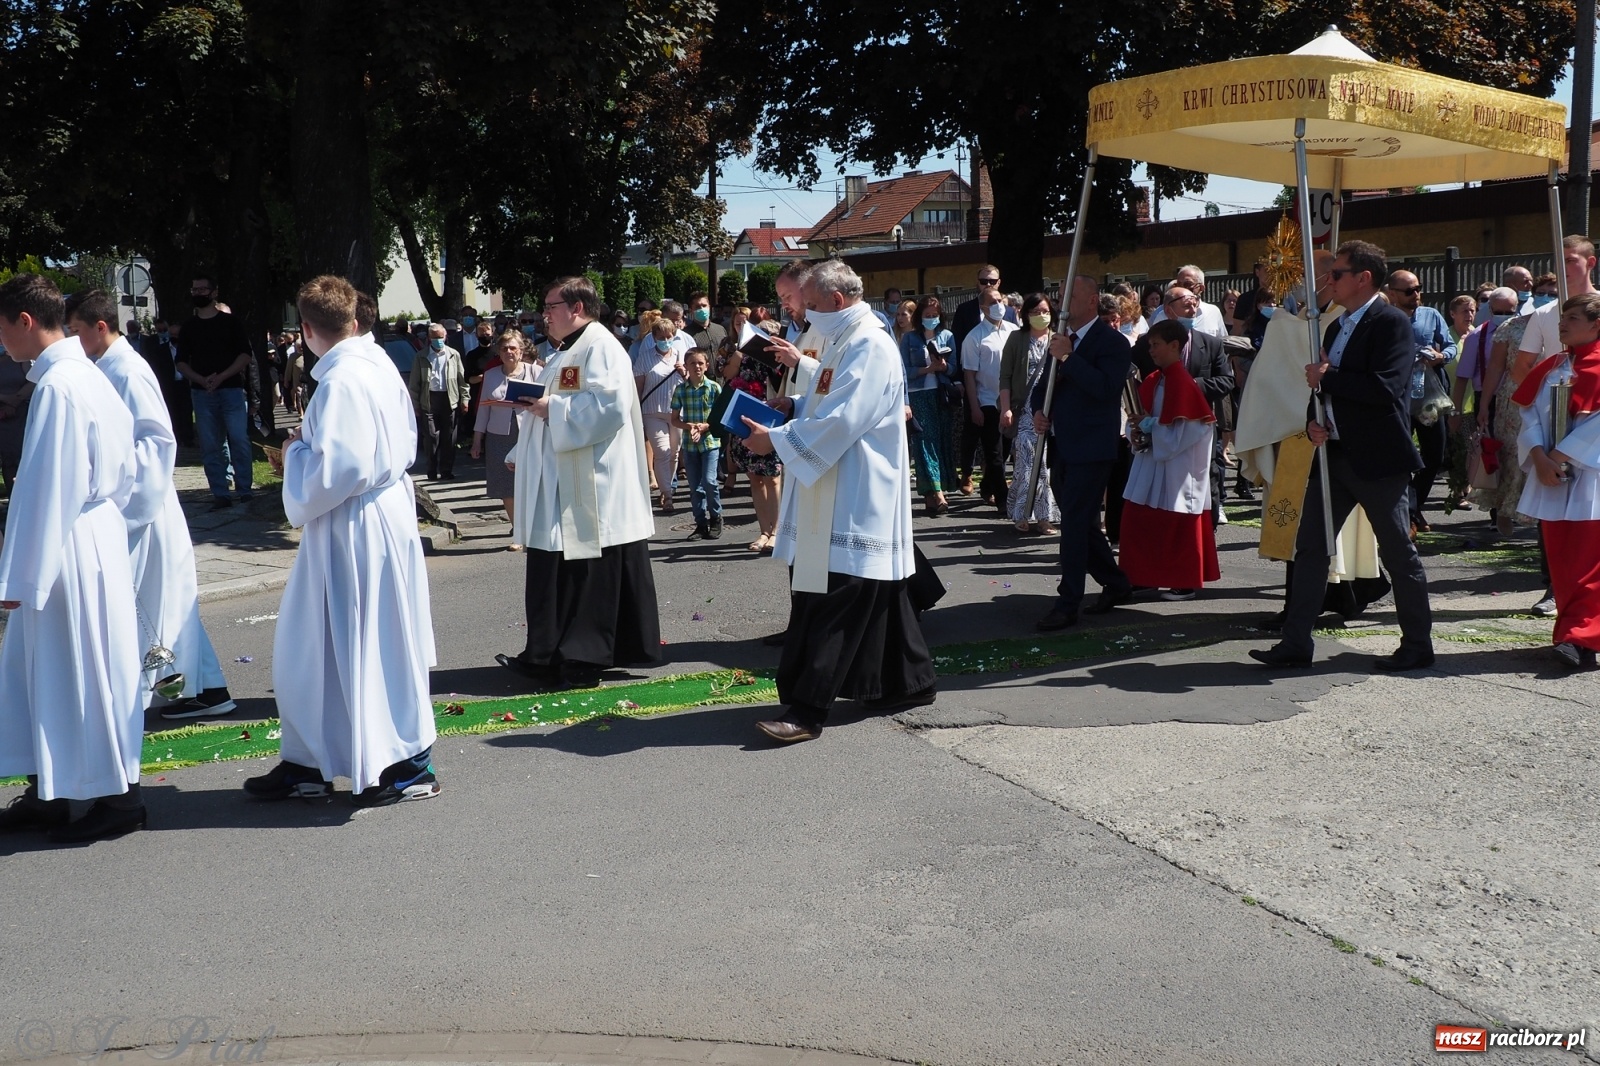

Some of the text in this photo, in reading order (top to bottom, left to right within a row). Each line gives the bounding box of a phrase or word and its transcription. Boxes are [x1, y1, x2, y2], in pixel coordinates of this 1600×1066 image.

[1183, 87, 1213, 111] KRWI
[1221, 77, 1327, 106] CHRYSTUSOWA
[1386, 88, 1415, 114] MNIE
